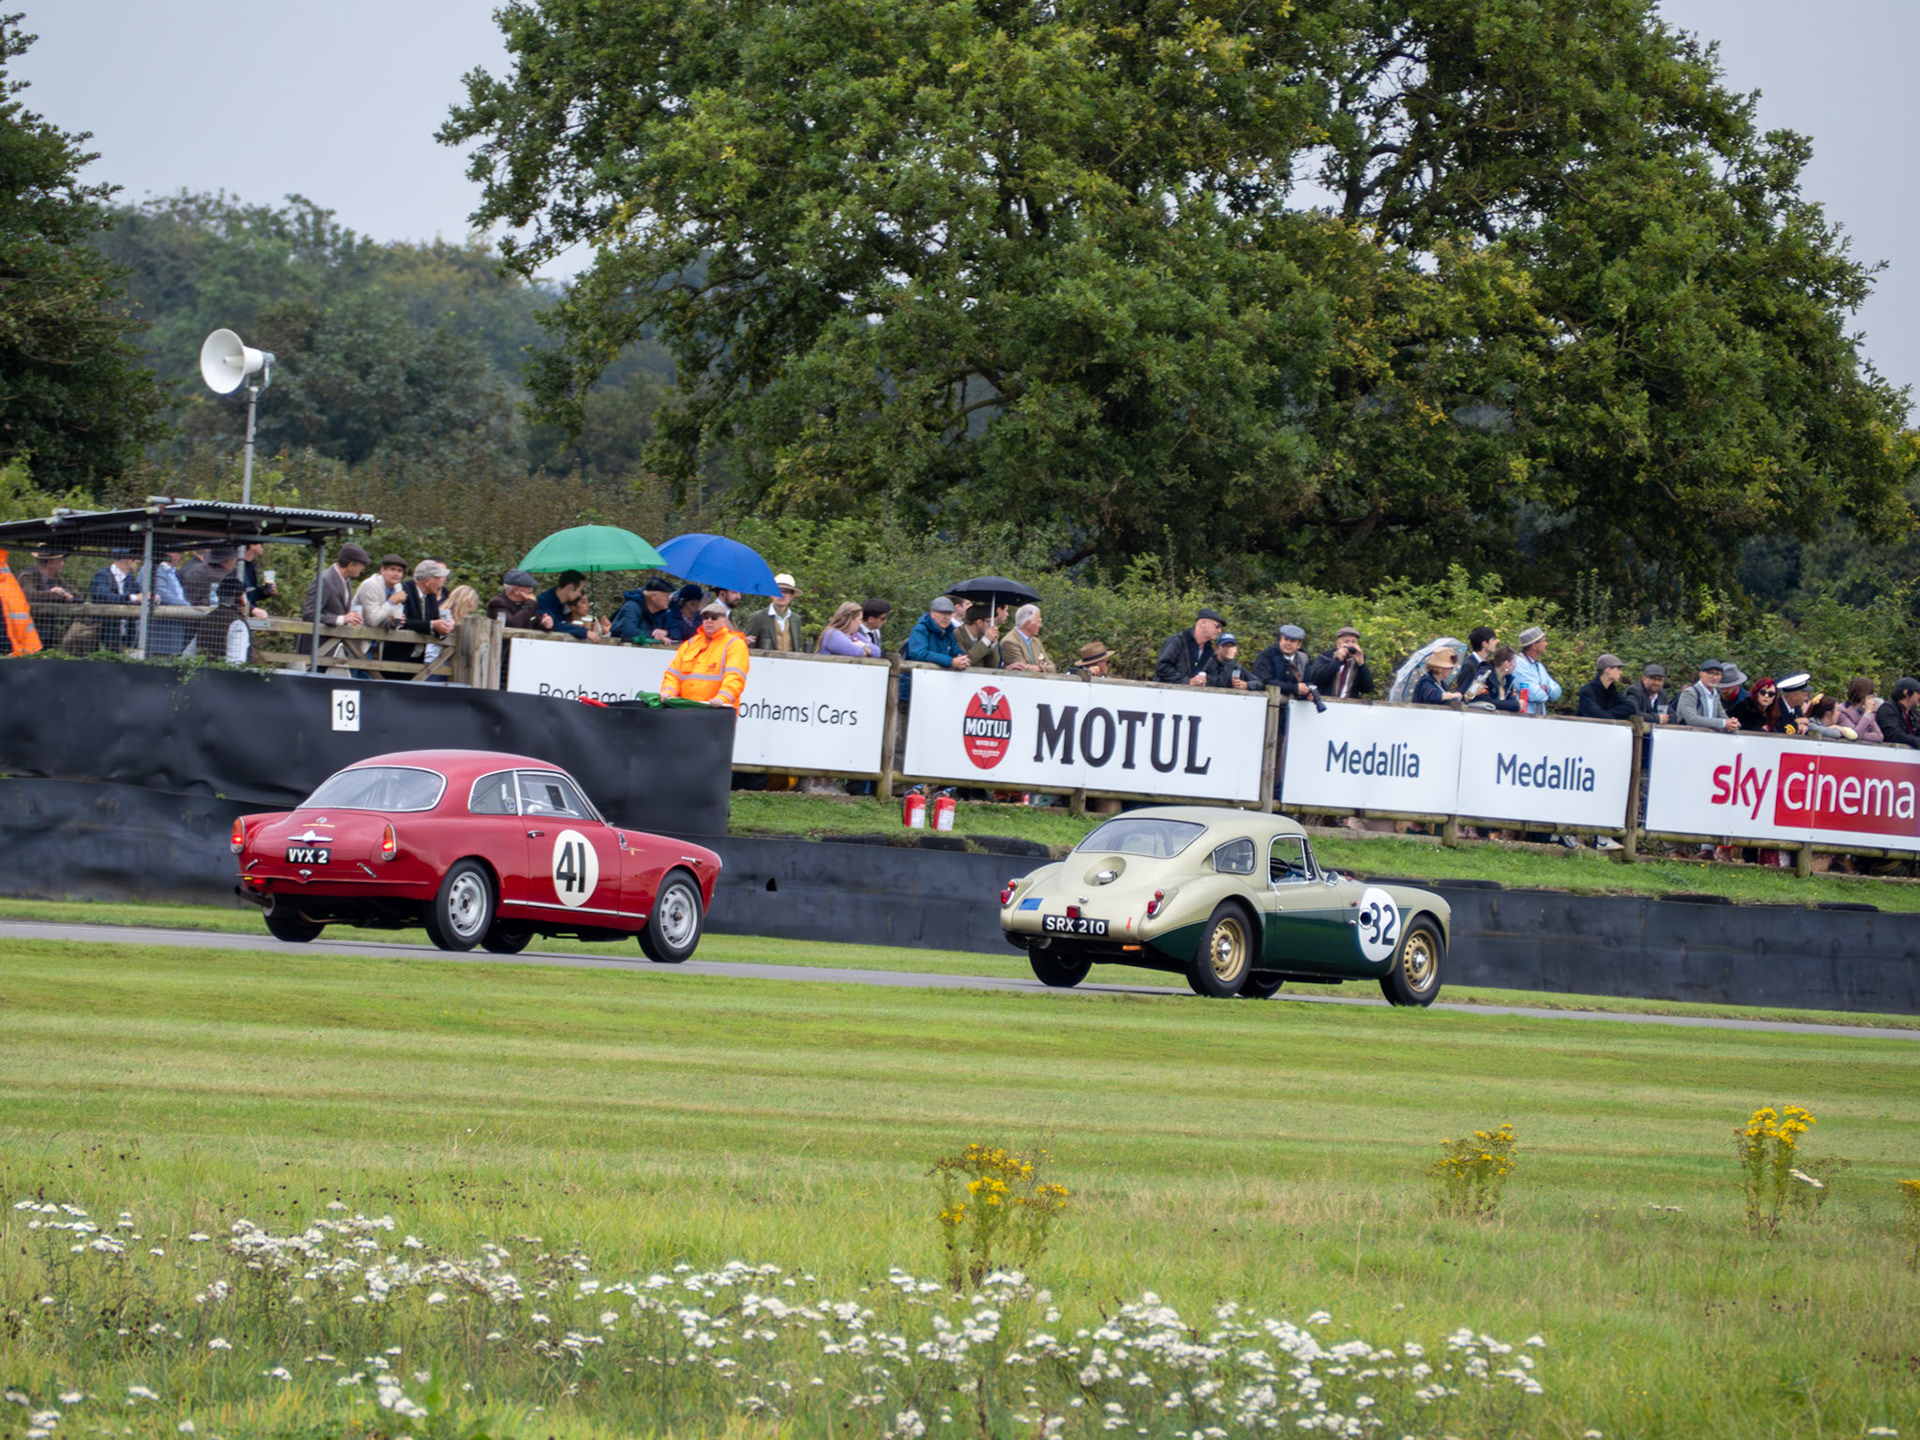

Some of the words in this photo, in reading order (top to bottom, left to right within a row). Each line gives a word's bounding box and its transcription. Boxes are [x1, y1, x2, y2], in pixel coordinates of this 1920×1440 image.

[336, 700, 356, 721] 19
[738, 698, 809, 723] onhams
[965, 717, 1010, 738] MOTUL
[1033, 703, 1211, 775] MOTUL
[1325, 740, 1420, 778] Medallia
[1496, 752, 1595, 792] Medallia
[1711, 752, 1773, 820] sky
[1783, 762, 1915, 819] cinema
[289, 848, 315, 863] VYX
[317, 850, 328, 864] 2
[556, 841, 586, 893] 41
[1046, 916, 1075, 933] SRX
[1078, 919, 1106, 935] 210
[1368, 902, 1396, 947] 32
